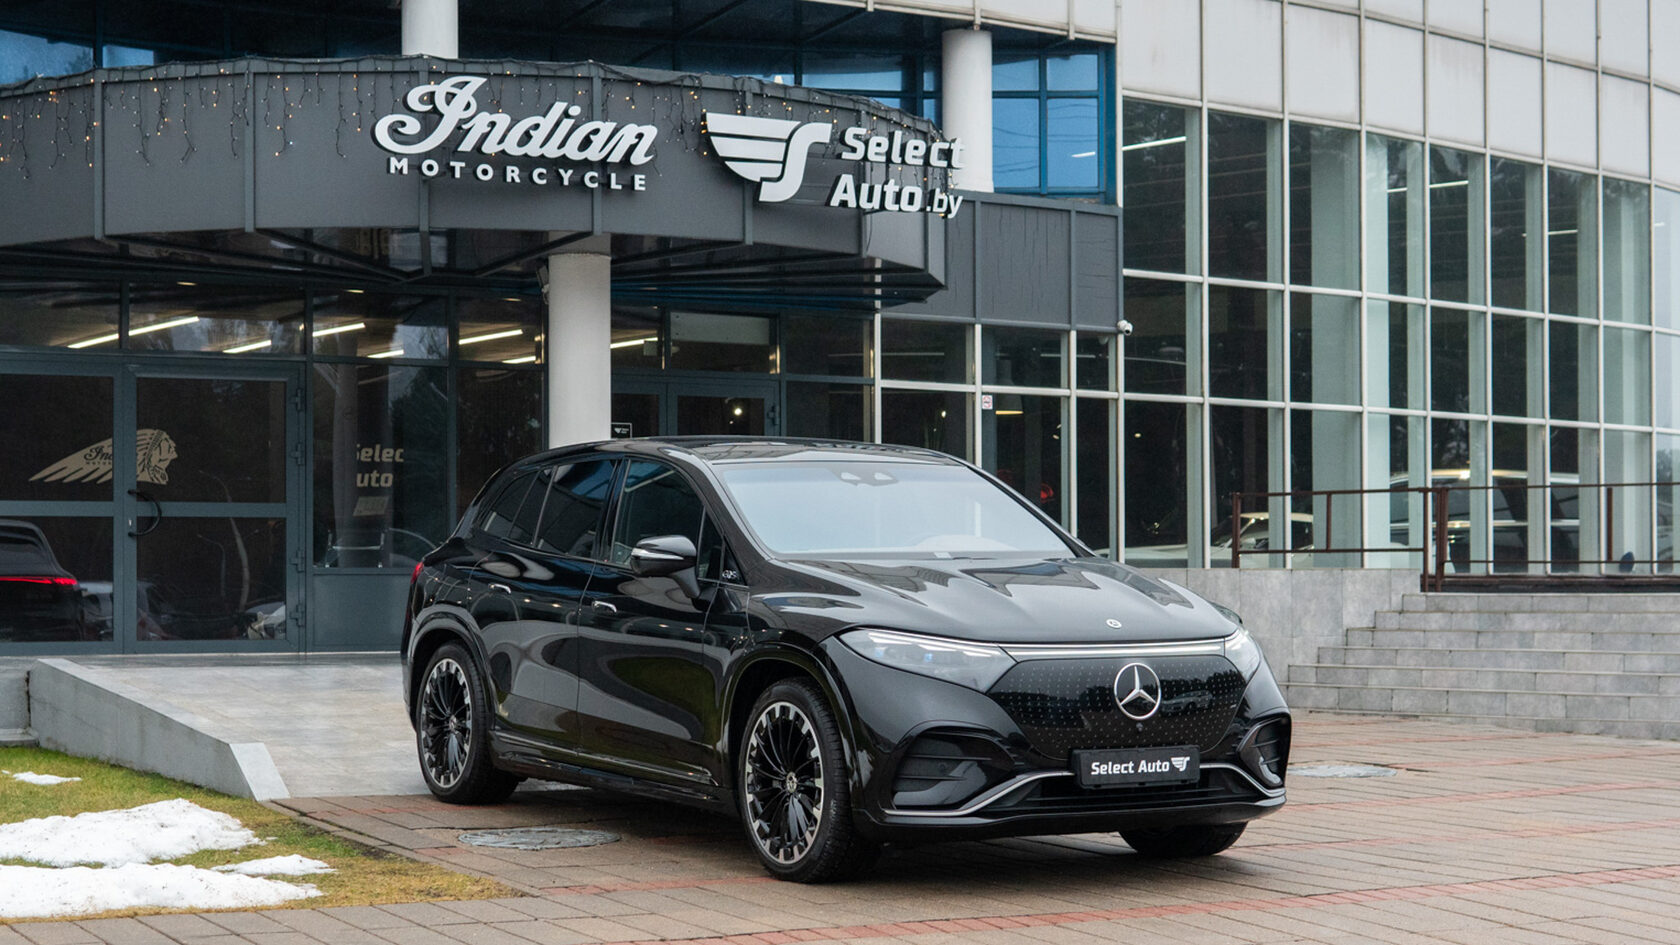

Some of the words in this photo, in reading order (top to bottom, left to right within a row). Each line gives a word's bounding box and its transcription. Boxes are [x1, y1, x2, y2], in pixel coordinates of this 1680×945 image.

[374, 76, 658, 165] Indian
[841, 127, 965, 168] Select
[389, 156, 647, 191] MOTORCYCLE
[830, 174, 963, 219] Auto.by
[356, 470, 393, 487] uto
[1091, 761, 1135, 775] Select
[1138, 760, 1170, 773] Auto
